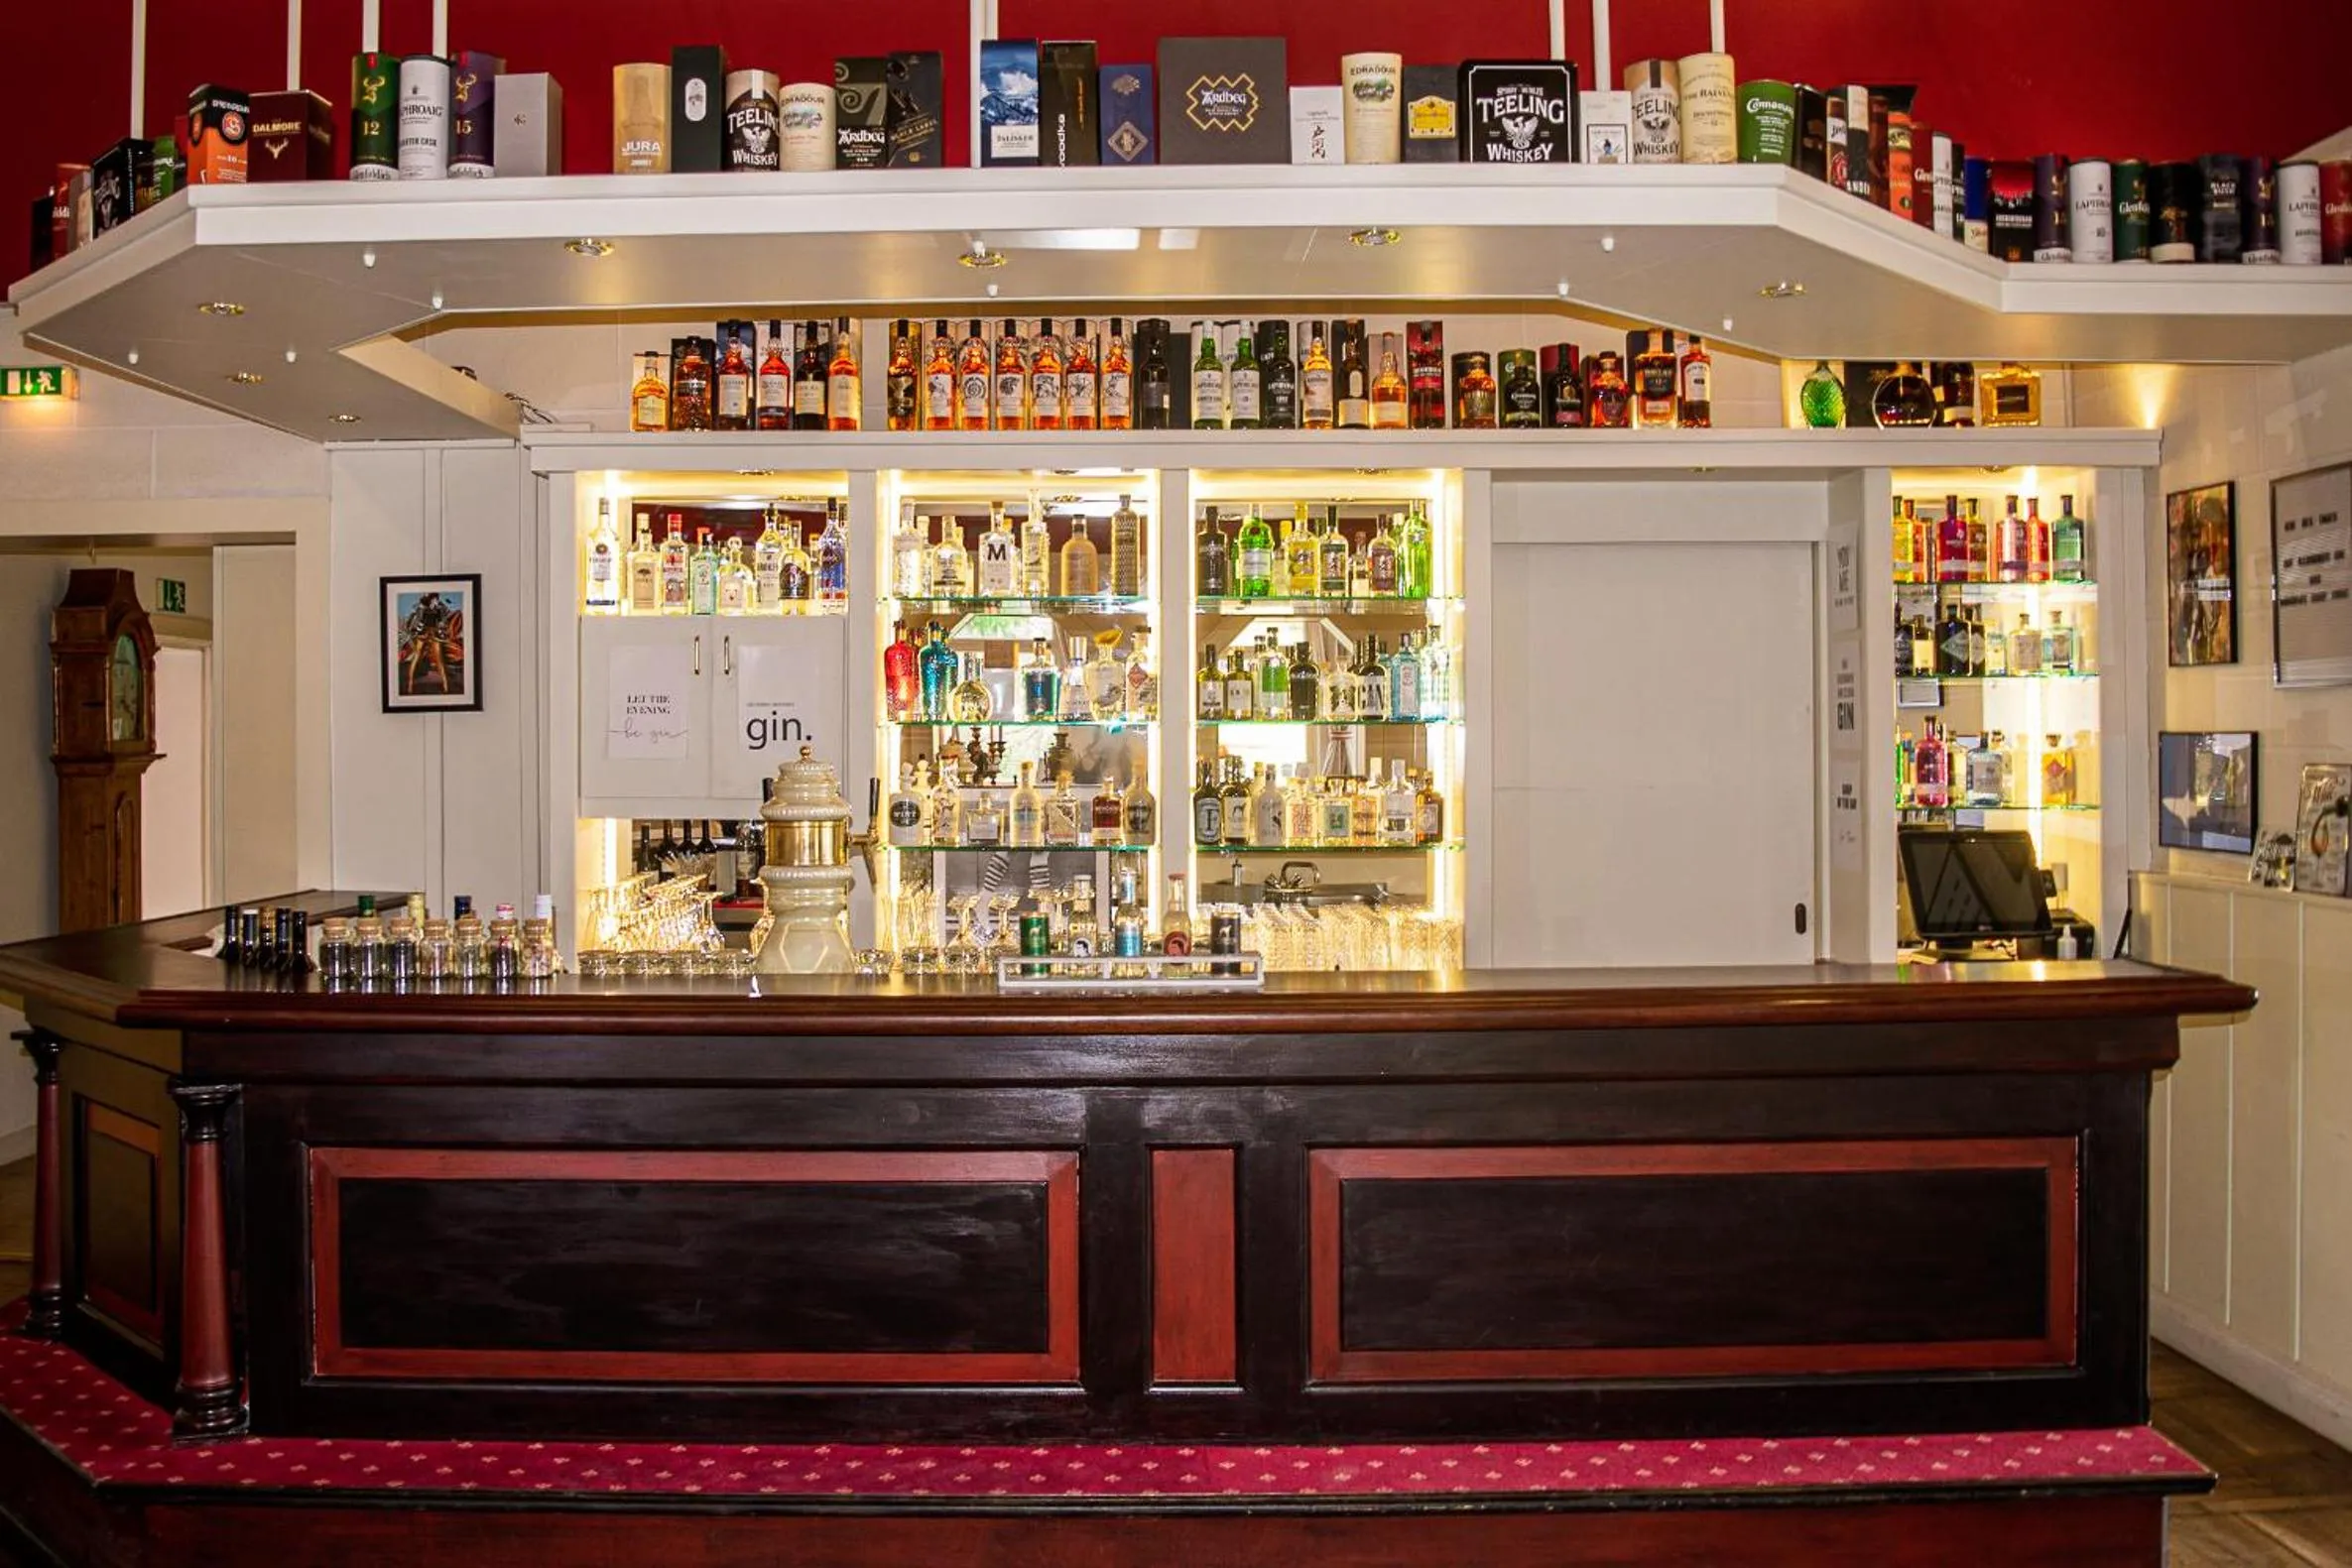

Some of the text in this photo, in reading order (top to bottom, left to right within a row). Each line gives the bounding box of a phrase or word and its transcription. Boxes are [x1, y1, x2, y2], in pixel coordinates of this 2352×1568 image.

[401, 104, 444, 117] PHROAIG
[1476, 94, 1564, 124] TEELING
[252, 121, 302, 132] DALMORE
[362, 121, 380, 136] 12
[456, 120, 472, 135] 15
[838, 128, 885, 145] Ardbeg
[621, 141, 662, 153] JURA
[1486, 142, 1553, 163] WHISKEY
[1634, 142, 1680, 156] WHISKEY
[732, 149, 779, 167] WHISKEY
[987, 543, 1007, 561] M
[627, 695, 646, 704] LET
[1837, 701, 1855, 731] GIN
[746, 710, 812, 751] gin.
